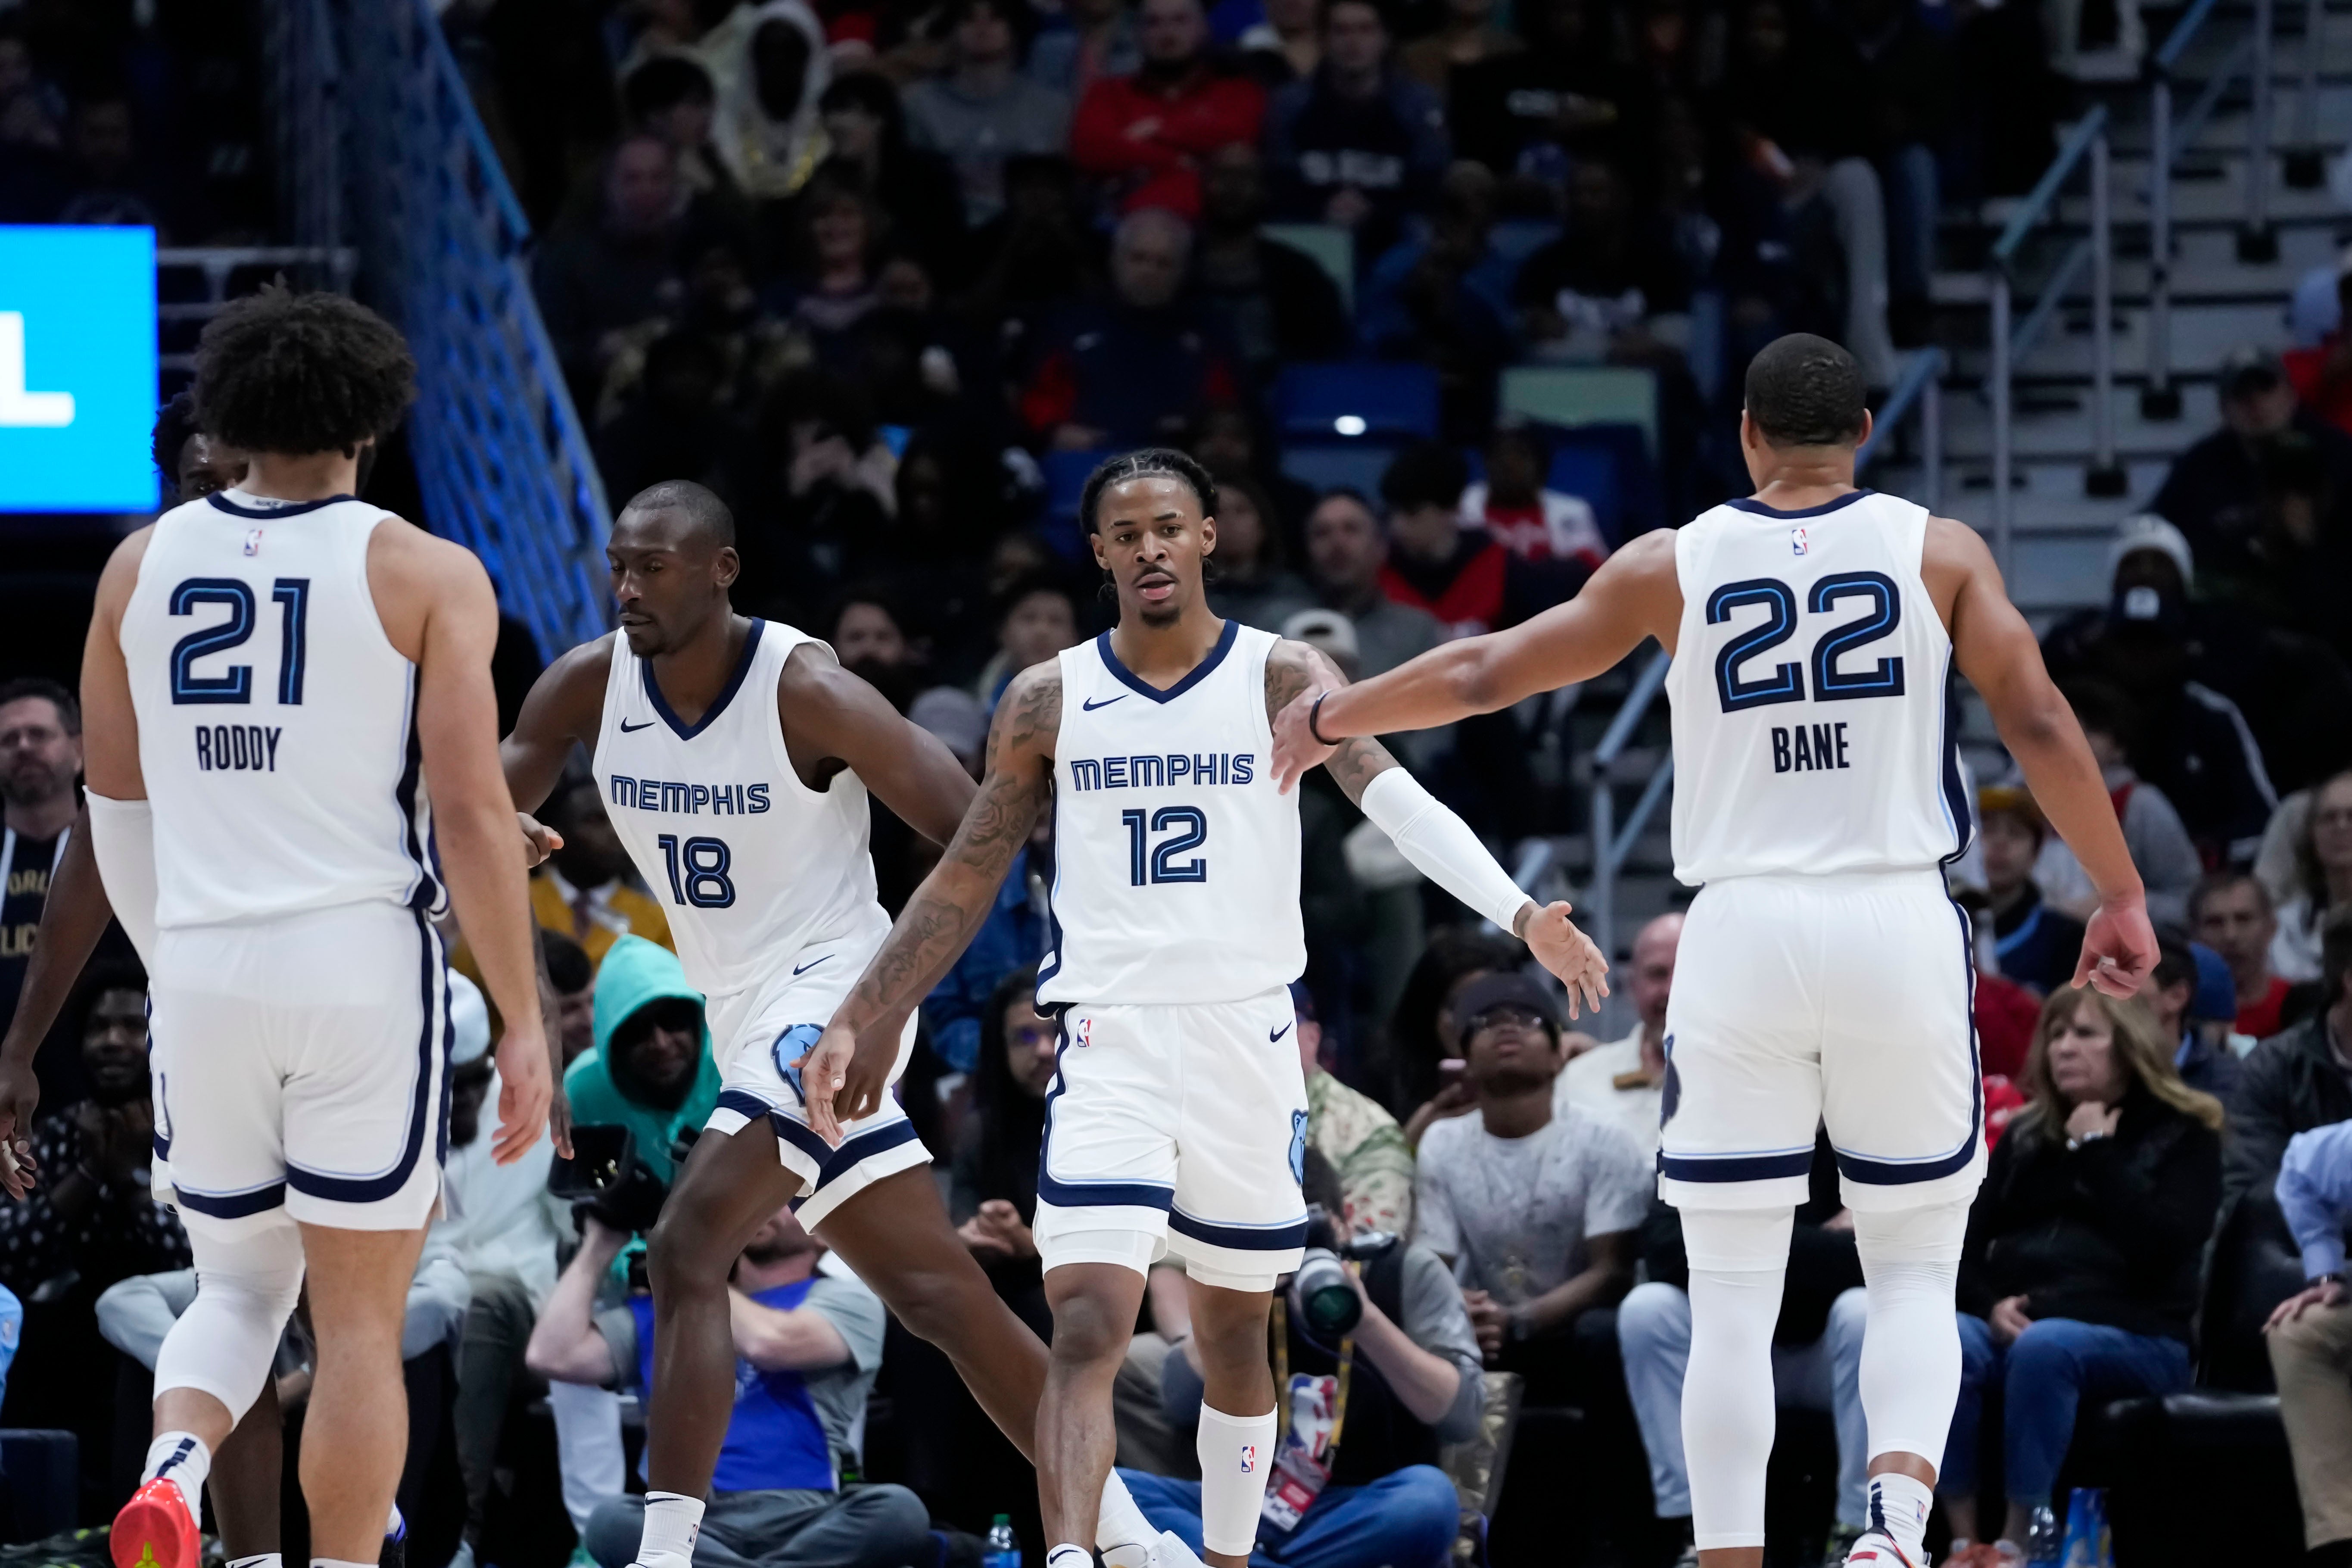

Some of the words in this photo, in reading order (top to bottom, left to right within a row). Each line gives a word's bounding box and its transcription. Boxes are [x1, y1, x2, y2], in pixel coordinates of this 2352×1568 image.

[169, 577, 310, 705] 21
[1706, 571, 1905, 714] 22
[196, 725, 282, 772] RODDY
[1070, 753, 1254, 791] MEMPHIS
[1771, 722, 1850, 773] BANE
[611, 774, 771, 815] MEMPHIS
[658, 833, 736, 909] 18
[1122, 806, 1207, 886] 12
